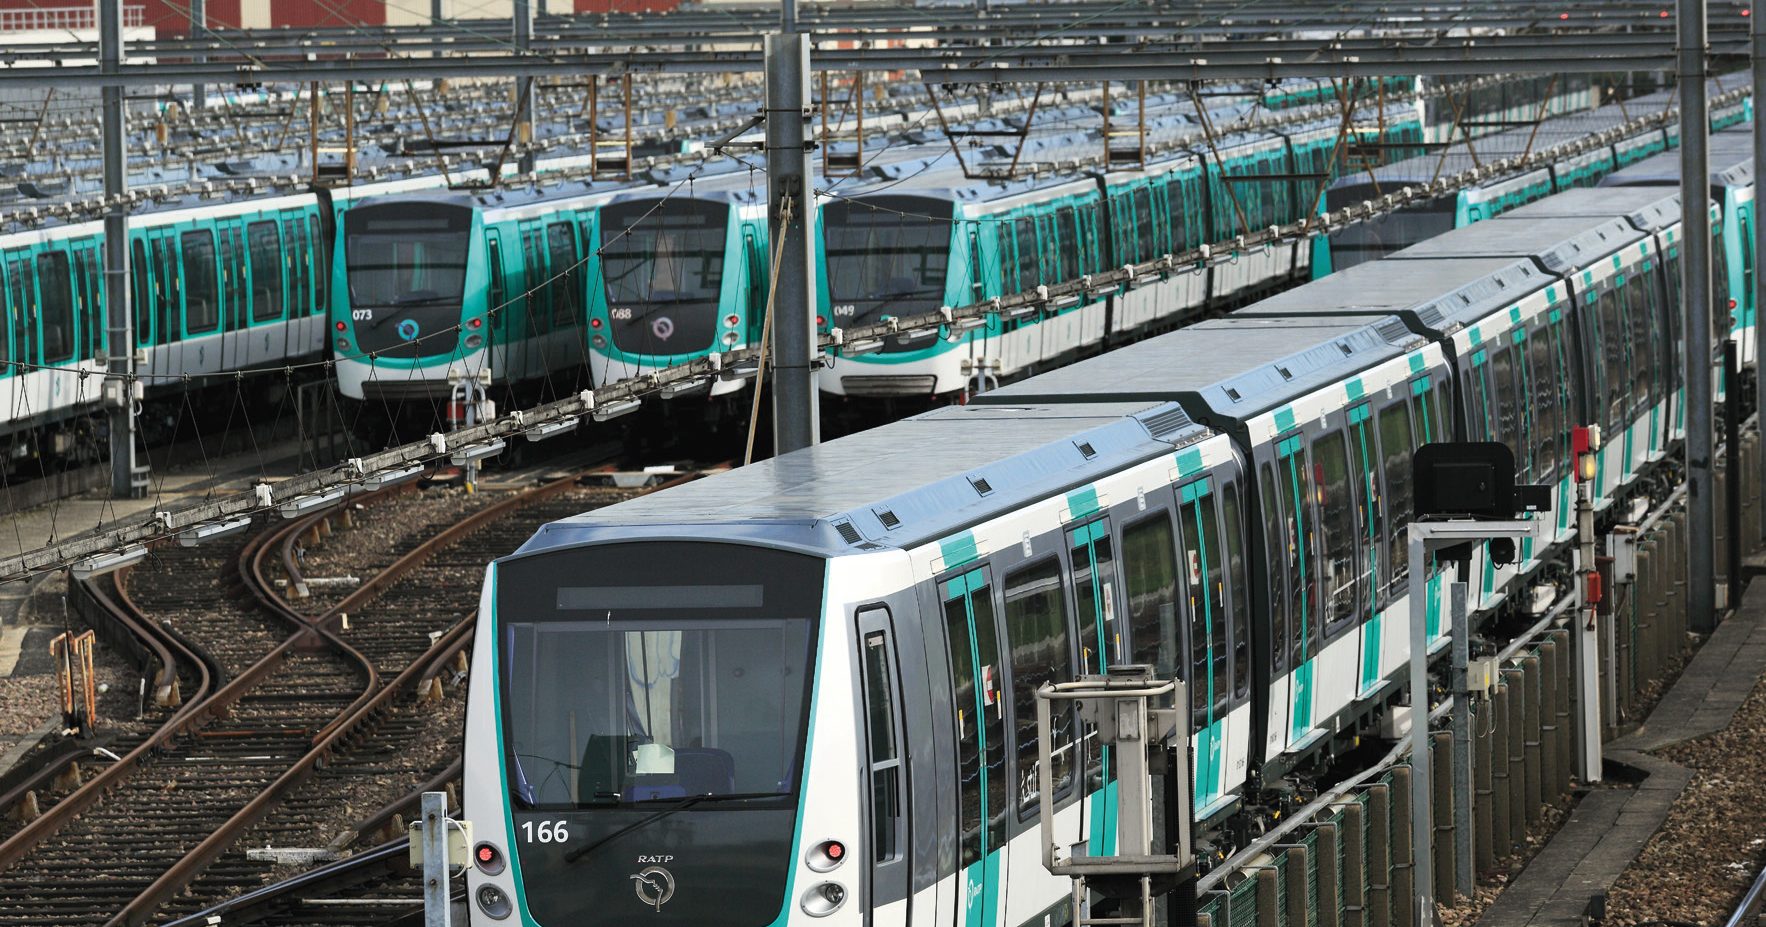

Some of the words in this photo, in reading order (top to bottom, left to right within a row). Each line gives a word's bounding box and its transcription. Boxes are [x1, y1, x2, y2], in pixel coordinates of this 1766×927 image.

[352, 309, 373, 320] 073
[834, 305, 855, 316] 049
[521, 820, 569, 843] 166
[637, 855, 674, 863] RATP
